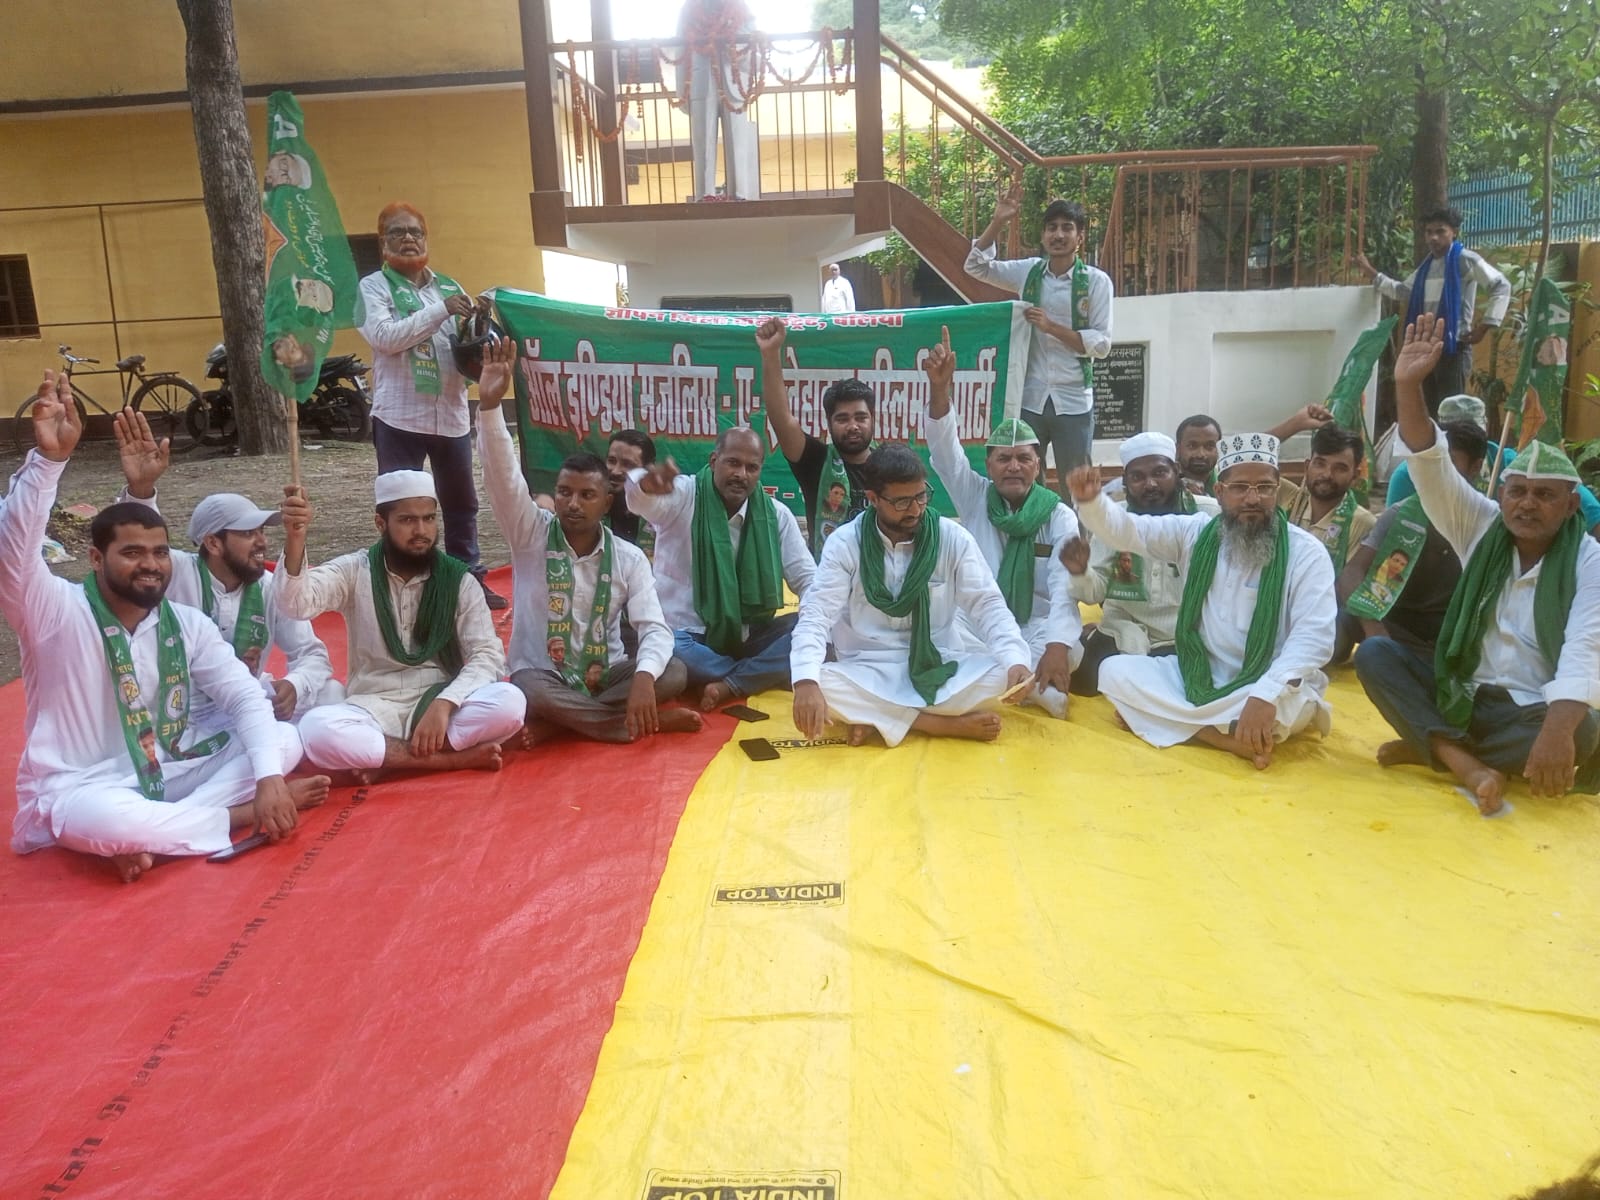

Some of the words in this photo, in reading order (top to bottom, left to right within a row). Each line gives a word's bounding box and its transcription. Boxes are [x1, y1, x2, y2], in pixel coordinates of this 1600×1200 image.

[520, 337, 568, 429] ऑल
[126, 709, 152, 727] KIT
[725, 888, 770, 901] TOP
[774, 883, 835, 900] INDIA
